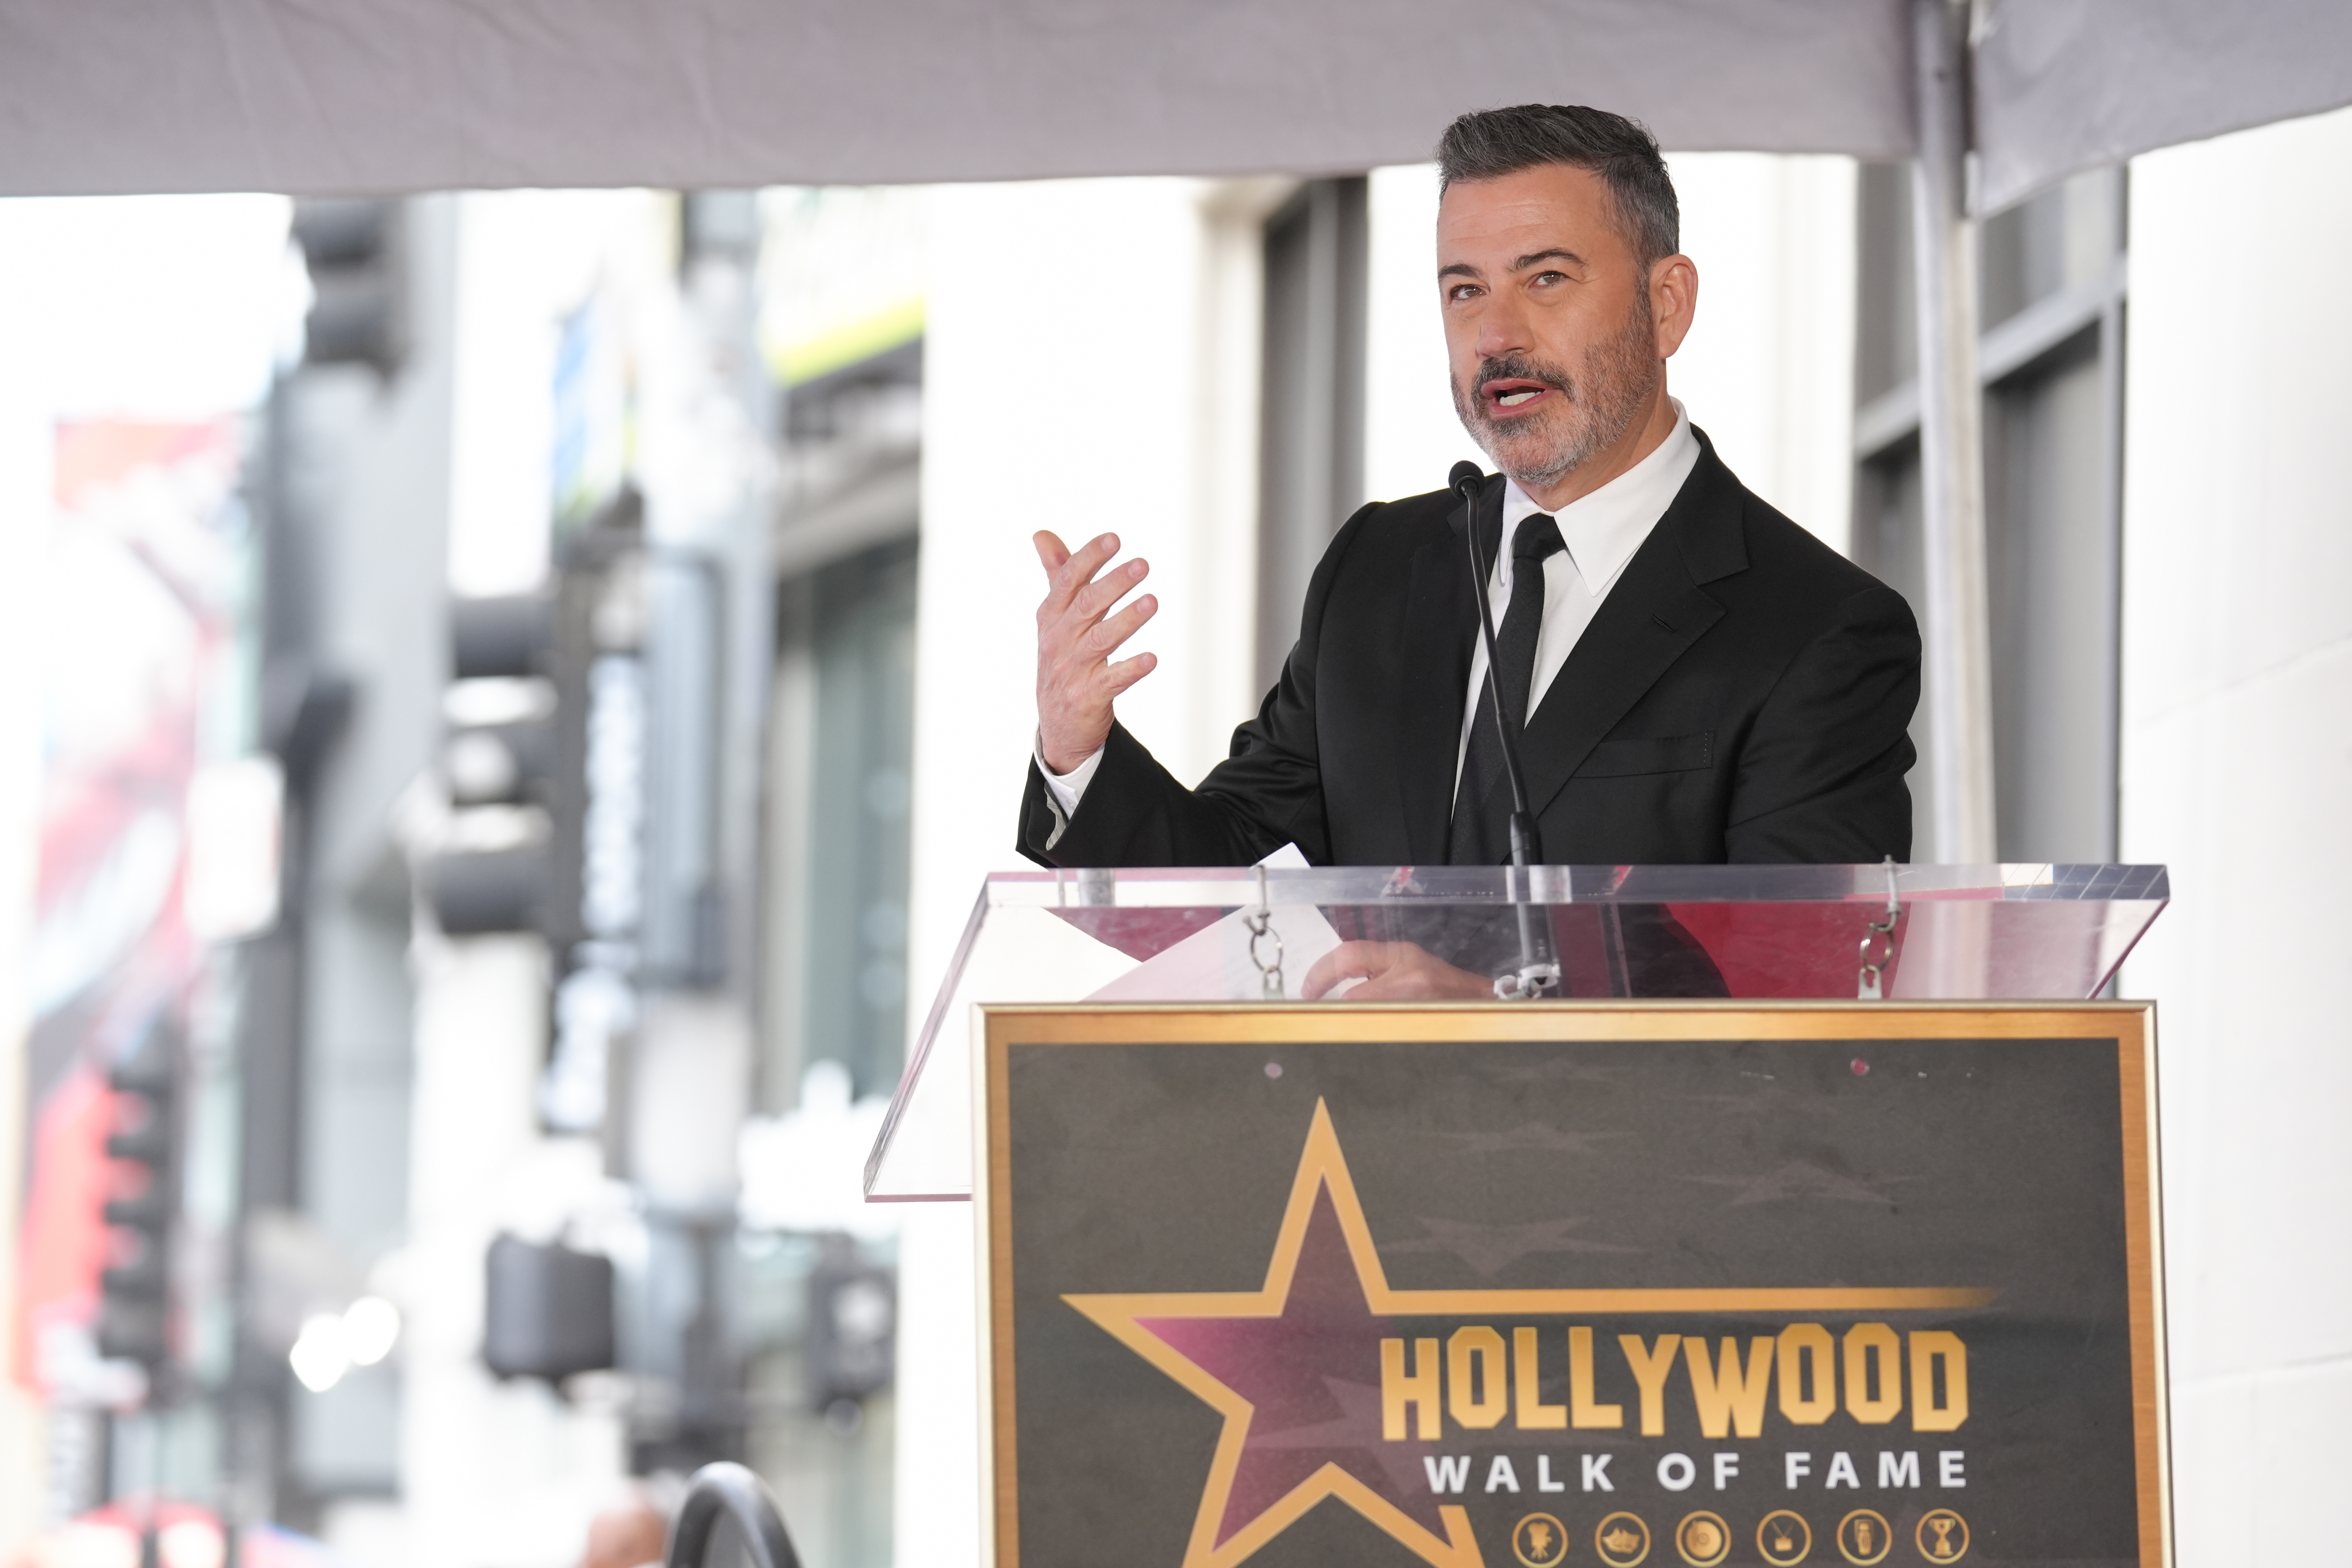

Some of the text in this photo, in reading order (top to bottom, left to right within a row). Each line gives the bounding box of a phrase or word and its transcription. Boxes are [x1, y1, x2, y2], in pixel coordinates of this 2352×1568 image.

[1380, 1323, 1969, 1442] HOLLYWOOD
[1422, 1451, 1966, 1494] WALK OF FAME
